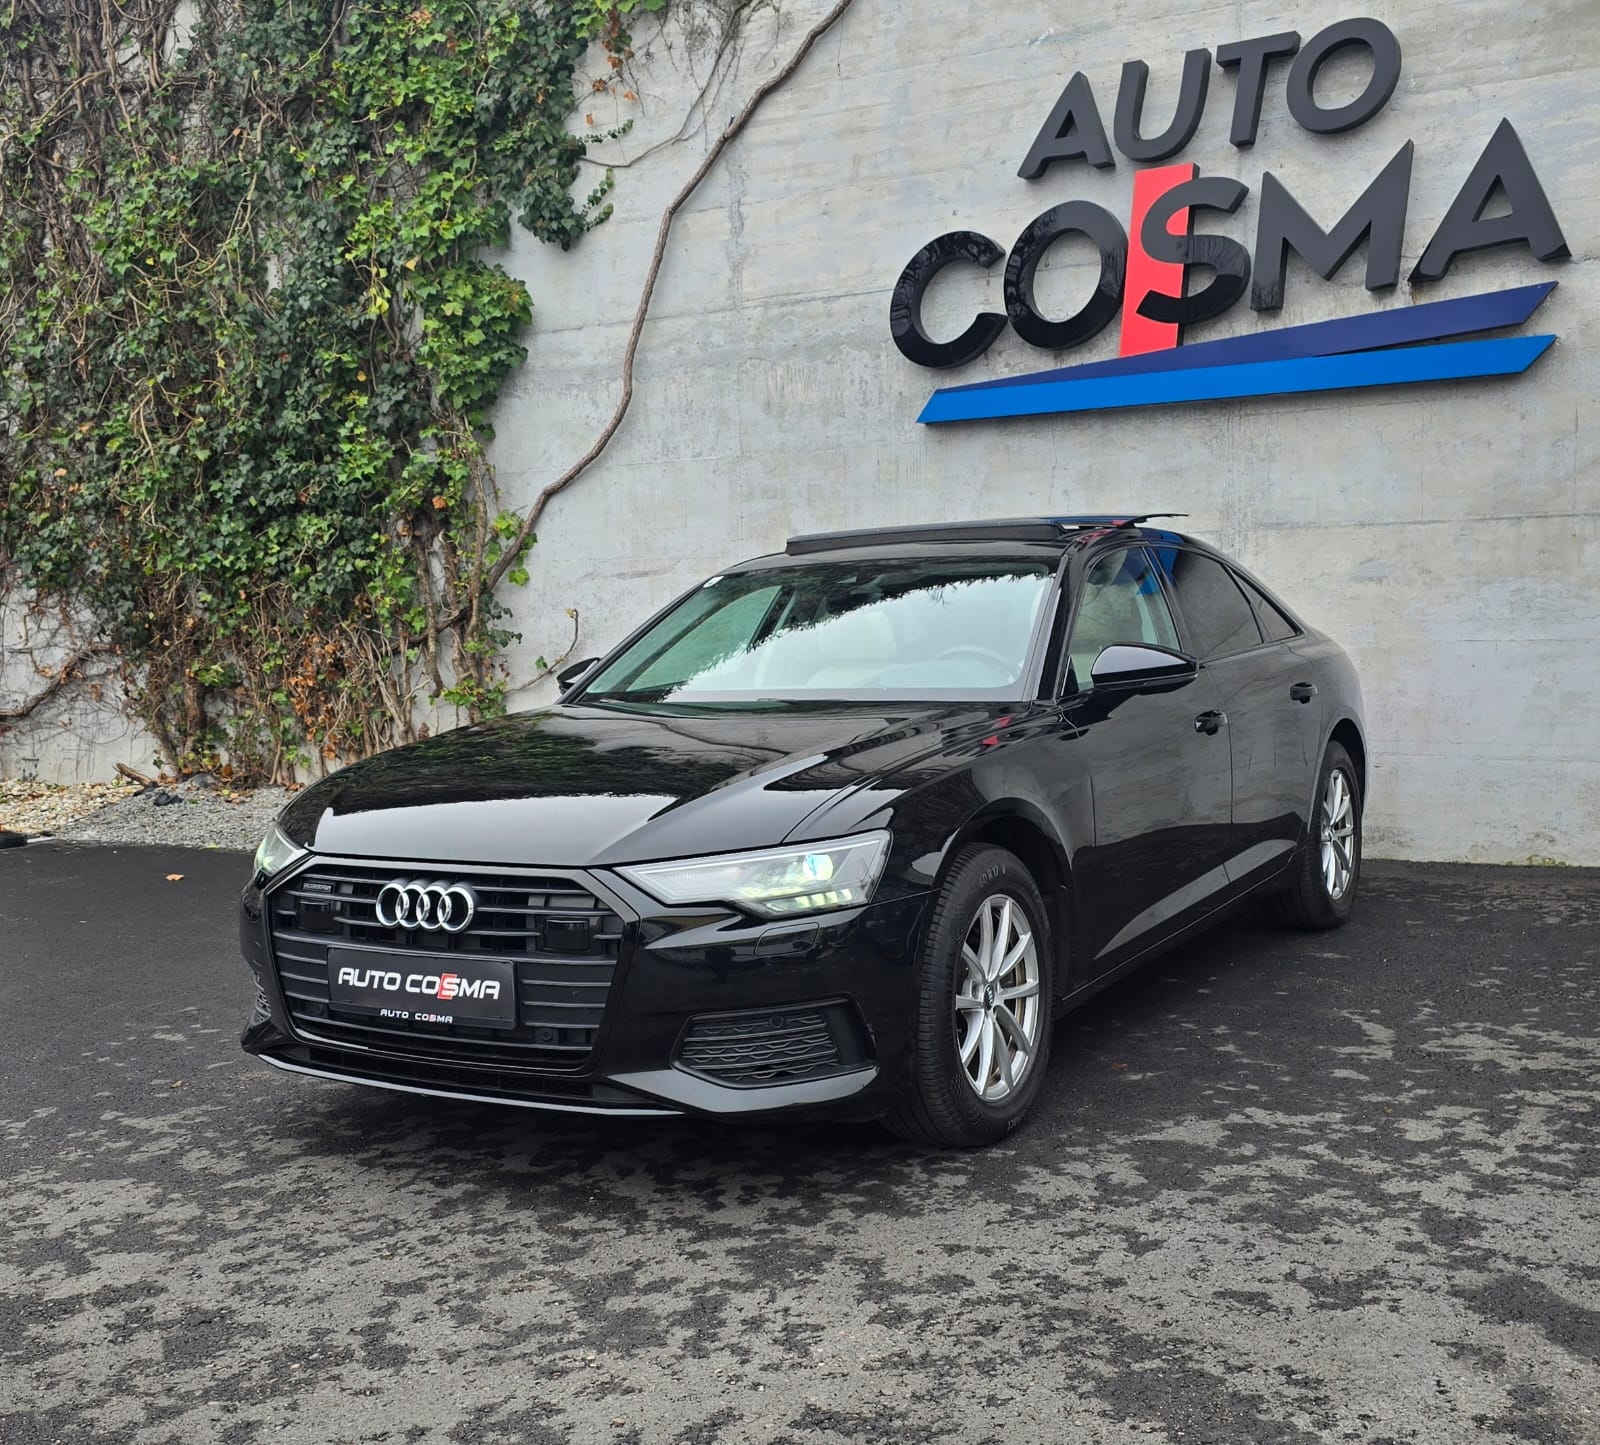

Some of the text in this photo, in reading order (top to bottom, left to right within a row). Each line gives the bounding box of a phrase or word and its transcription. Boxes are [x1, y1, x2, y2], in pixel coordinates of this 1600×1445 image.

[1016, 16, 1402, 181] AUTO
[889, 117, 1573, 369] COSMA
[338, 967, 501, 1000] AUTO COSMA
[380, 1008, 454, 1024] AUTO COSMA
